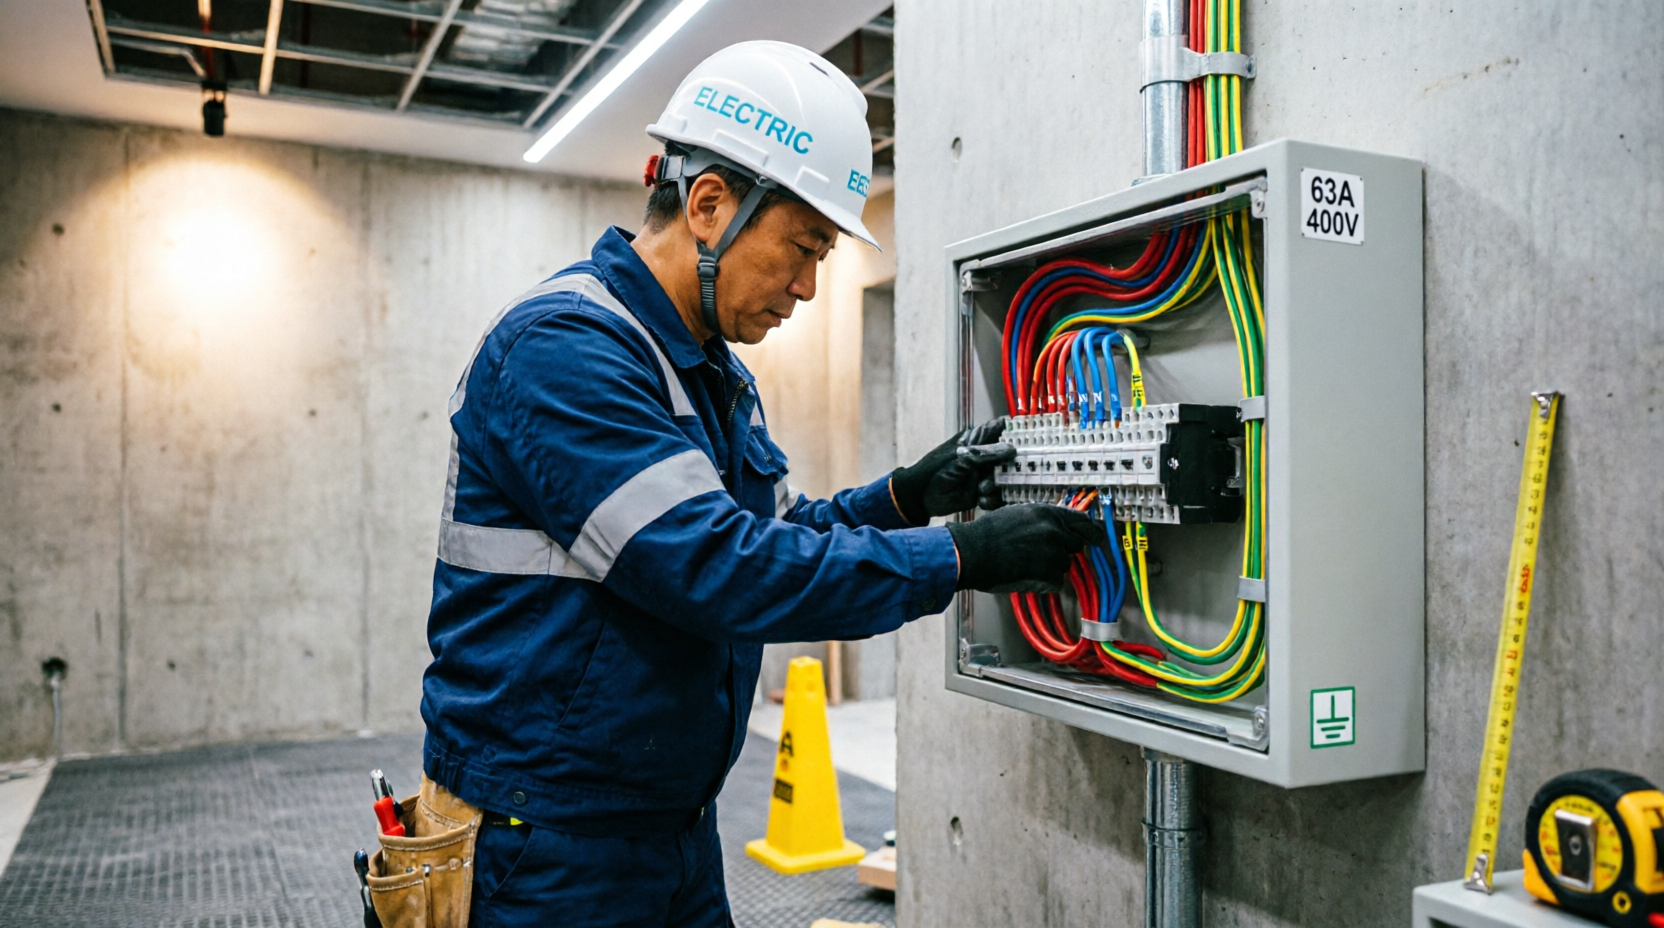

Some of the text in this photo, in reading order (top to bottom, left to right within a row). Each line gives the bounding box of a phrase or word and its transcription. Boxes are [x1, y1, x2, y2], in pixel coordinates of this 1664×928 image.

[694, 86, 814, 155] ELECTRIC
[1311, 176, 1355, 208] 63A
[1306, 207, 1359, 237] 400V
